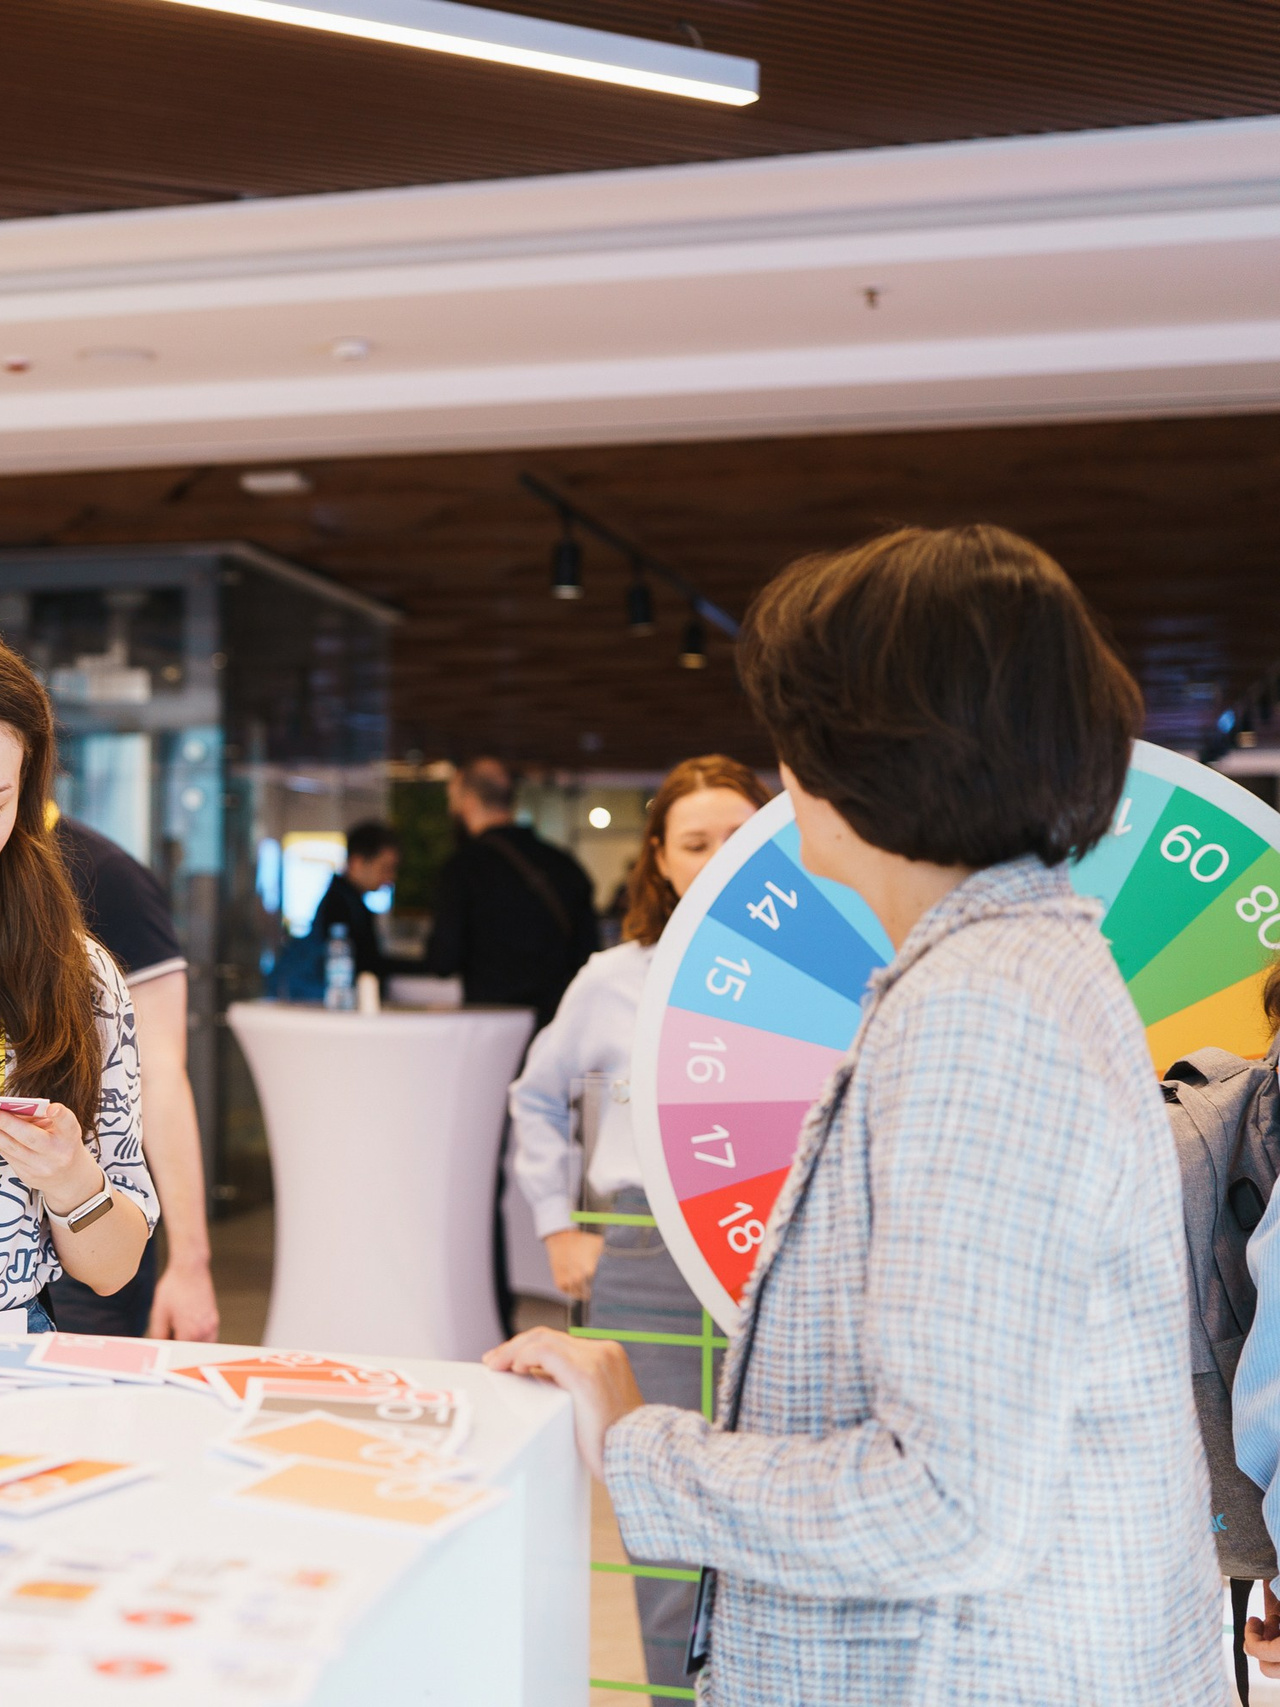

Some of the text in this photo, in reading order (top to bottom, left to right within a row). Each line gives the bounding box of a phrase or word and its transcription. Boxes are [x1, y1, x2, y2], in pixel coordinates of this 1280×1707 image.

[745, 880, 798, 931] 14
[705, 955, 752, 1002] 15
[686, 1036, 727, 1084] 16
[691, 1124, 736, 1169] 17
[717, 1201, 766, 1254] 18
